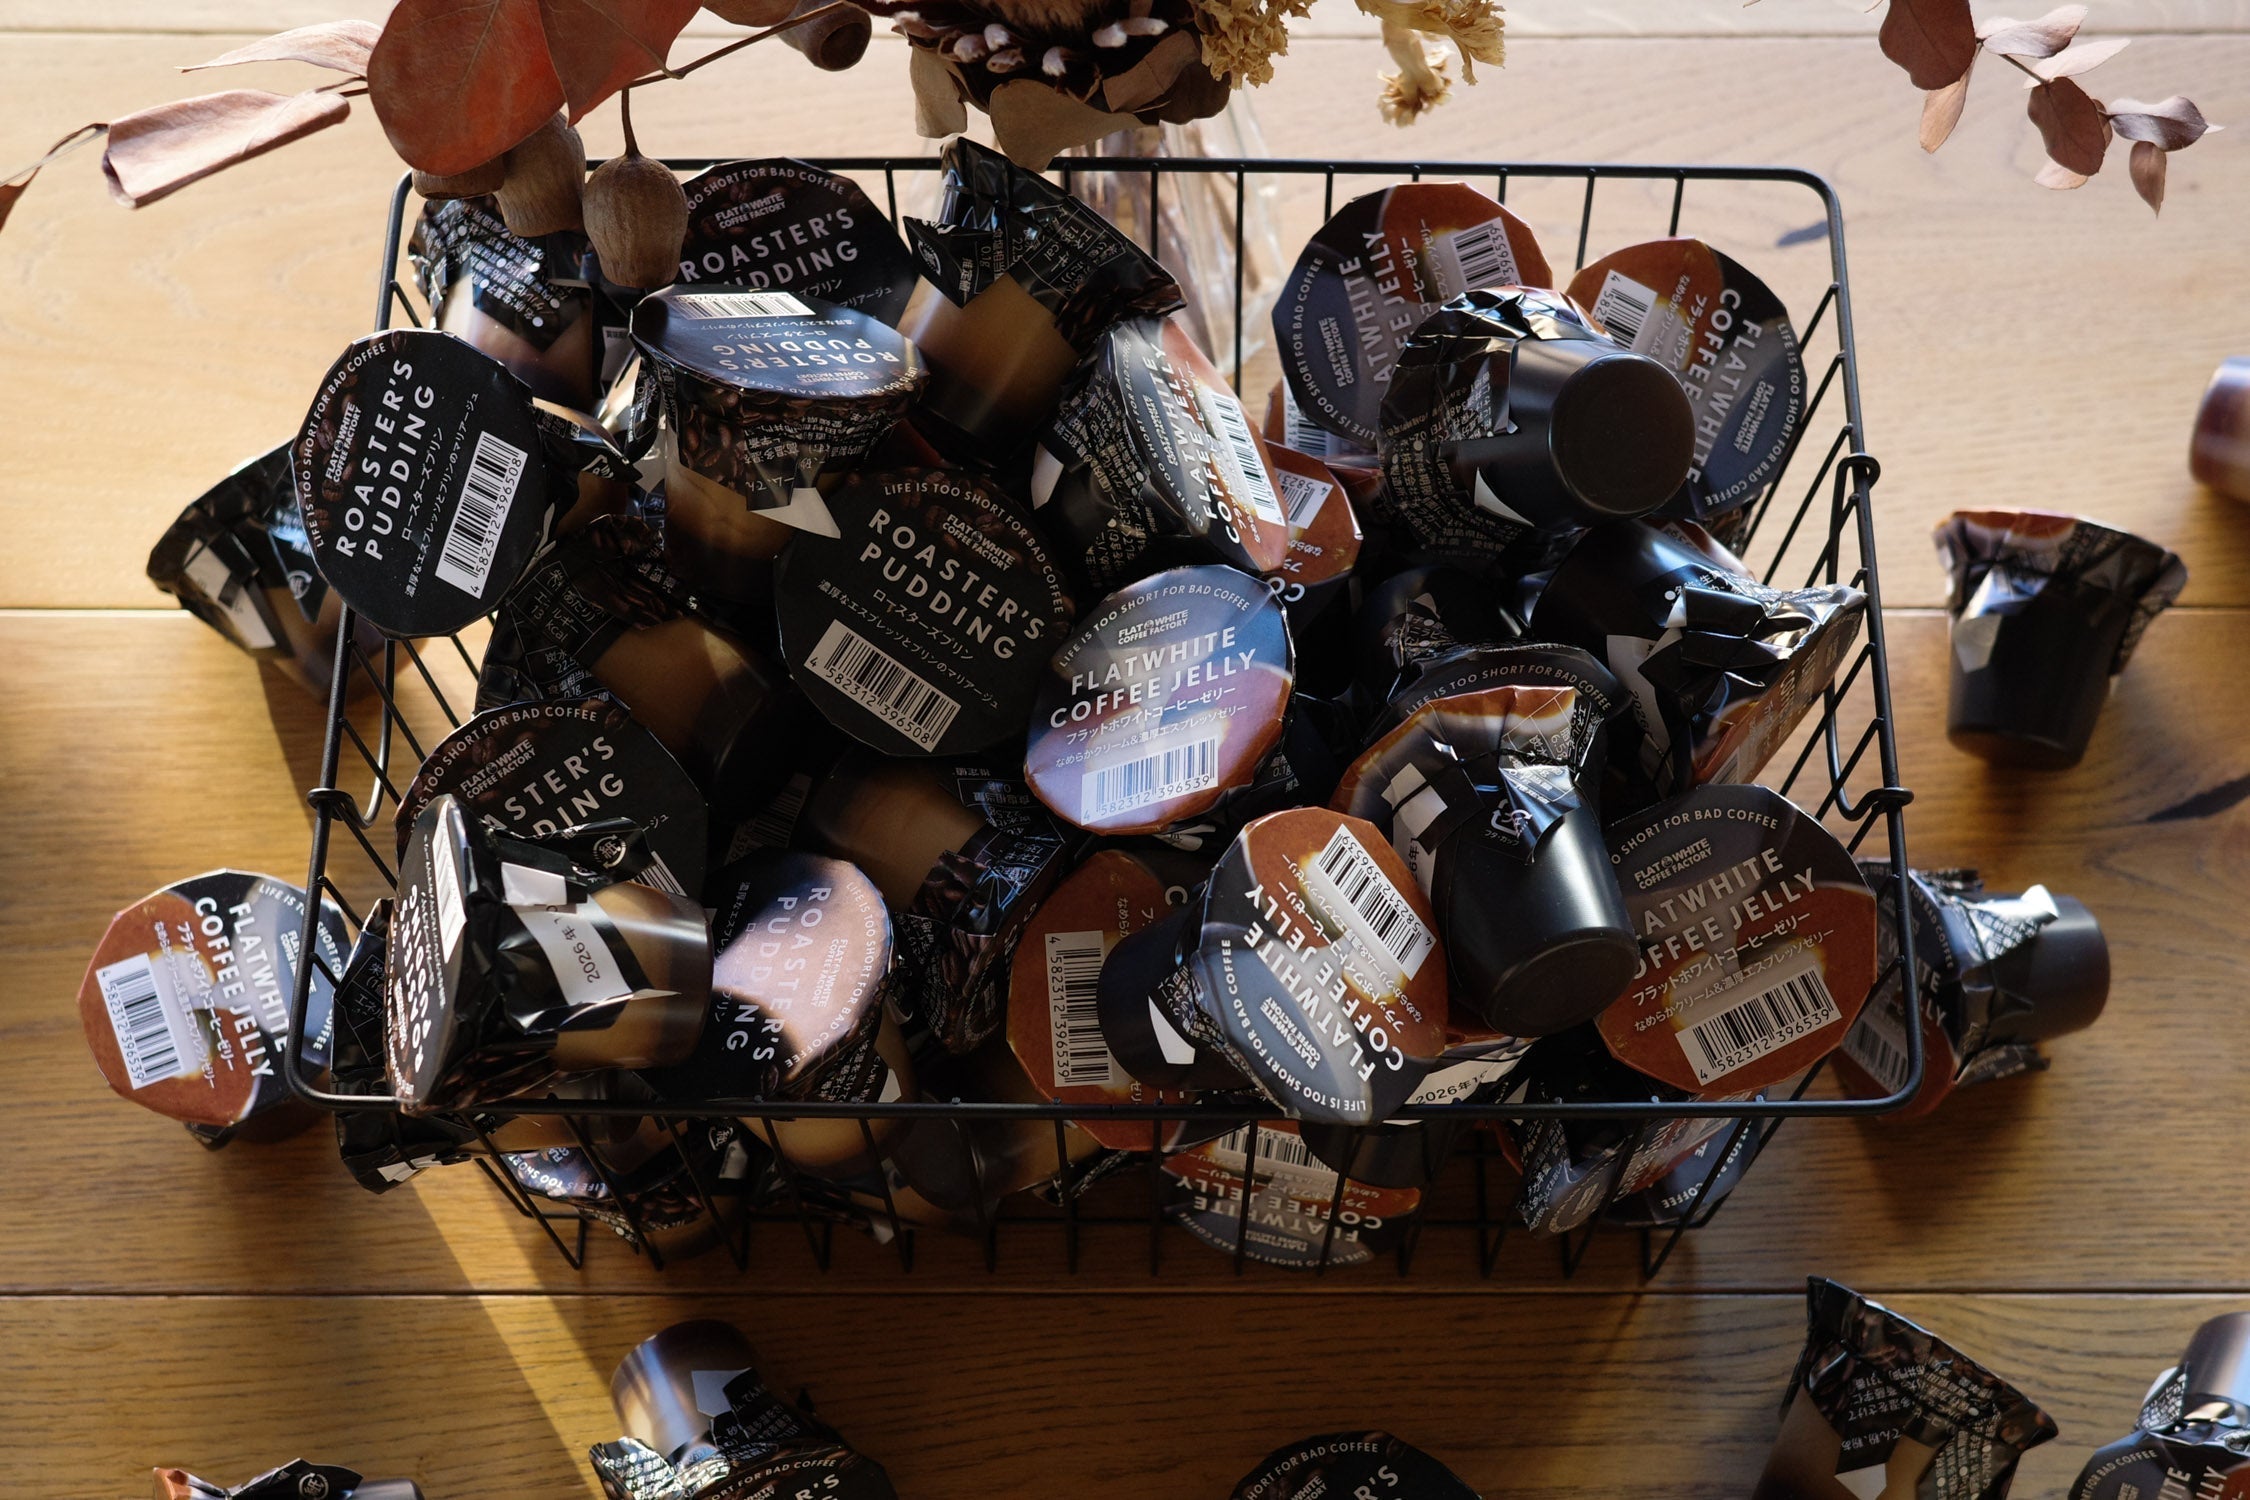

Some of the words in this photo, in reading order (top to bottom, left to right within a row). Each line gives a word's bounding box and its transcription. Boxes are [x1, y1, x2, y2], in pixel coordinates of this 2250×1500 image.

[703, 173, 740, 197] SHORT
[743, 168, 767, 180] FOR
[769, 167, 795, 178] BAD
[798, 171, 845, 195] COFFEE
[749, 192, 784, 211] WHITE
[750, 201, 786, 220] FACTORY
[680, 208, 855, 283] ROASTER'S
[1297, 257, 1324, 301] COFFEE
[1362, 232, 1405, 306] JELLY
[1292, 305, 1304, 330] BAD
[713, 338, 873, 357] PUDDING
[1293, 333, 1304, 358] FOR
[1683, 288, 1741, 401] COFFEE
[1778, 323, 1793, 350] LIFE
[348, 342, 387, 373] COFFEE
[719, 351, 900, 372] ROASTER'S
[327, 370, 347, 396] BAD
[1297, 361, 1320, 397] SHORT
[1789, 368, 1800, 394] TOO
[313, 394, 331, 420] FOR
[1318, 397, 1339, 418] TOO
[1338, 415, 1351, 428] IS
[1781, 399, 1798, 438] SHORT
[303, 424, 318, 466] SHORT
[344, 407, 363, 447] FACTORY
[1143, 357, 1218, 520] FLATWHITE
[1353, 423, 1376, 441] LIFE
[335, 359, 413, 557] ROASTER'S
[1767, 439, 1785, 462] FOR
[303, 473, 312, 499] TOO
[364, 385, 435, 560] PUDDING
[401, 427, 443, 541] ロースターズプリン
[1749, 461, 1770, 482] BAD
[304, 503, 314, 517] IS
[1705, 480, 1747, 505] COFFEE
[310, 519, 324, 548] LIFE
[476, 520, 500, 575] 582312
[495, 457, 523, 514] 396508
[884, 482, 912, 496] LIFE
[916, 482, 928, 493] IS
[933, 482, 961, 497] TOO
[964, 490, 1006, 520] SHORT
[1005, 515, 1028, 538] FOR
[1025, 536, 1046, 563] BAD
[1042, 564, 1065, 614] COFFEE
[971, 542, 1011, 572] FACTORY
[982, 536, 1016, 566] WHITE
[868, 508, 1045, 640] ROASTER'S
[859, 542, 1016, 660] PUDDING
[1059, 645, 1081, 668] LIFE
[1081, 632, 1092, 644] IS
[1093, 611, 1118, 633] TOO
[1121, 591, 1160, 615] SHORT
[1163, 585, 1186, 598] FOR
[1188, 584, 1212, 595] BAD
[1213, 587, 1250, 612] COFFEE
[1118, 625, 1145, 639] FLAT
[1153, 609, 1190, 627] WHITE
[1118, 632, 1148, 645] COFFEE
[1149, 618, 1189, 635] FACTORY
[1071, 626, 1237, 697] FLATWHITE
[826, 668, 876, 706] 582312
[880, 705, 930, 744] 396508
[1049, 676, 1161, 729] COFFEE
[1171, 648, 1257, 693] JELLY
[1406, 697, 1430, 716] LIFE
[1433, 685, 1447, 697] IS
[1450, 673, 1477, 689] TOO
[1481, 664, 1525, 680] SHORT
[1528, 664, 1552, 676] FOR
[1554, 669, 1578, 684] BAD
[1578, 680, 1611, 712] COFFEE
[422, 766, 445, 795] TOO
[442, 728, 482, 766] SHORT
[481, 715, 510, 736] FOR
[512, 706, 540, 722] BAD
[545, 706, 598, 722] COFFEE
[460, 770, 486, 793] FLAT
[496, 739, 534, 768] WHITE
[466, 776, 500, 800] COFFEE
[497, 748, 537, 779] FACTORY
[1101, 792, 1151, 817] 582312
[1158, 775, 1210, 798] 396539
[1621, 822, 1661, 856] SHORT
[1663, 812, 1690, 829] FOR
[1694, 807, 1722, 820] BAD
[1726, 808, 1779, 831] COFFEE
[1341, 835, 1382, 885] 396539
[1634, 860, 1663, 883] FLAT
[1670, 837, 1711, 862] WHITE
[1639, 868, 1673, 890] COFFEE
[1672, 847, 1713, 874] FACTORY
[259, 884, 283, 900] LIFE
[283, 896, 297, 907] IS
[846, 881, 864, 902] LIFE
[859, 899, 871, 913] IS
[1729, 866, 1817, 930] JELLY
[863, 912, 876, 937] TOO
[1244, 884, 1317, 959] JELLY
[1380, 885, 1422, 935] 582312
[726, 895, 798, 1052] PUDDING
[752, 887, 833, 1061] ROASTER'S
[864, 940, 876, 978] SHORT
[1221, 939, 1238, 995] COFFEE
[195, 897, 247, 1000] COFFEE
[229, 1003, 275, 1078] JELLY
[228, 902, 289, 1053] FLATWHITE
[847, 981, 867, 1005] FOR
[1050, 956, 1066, 1013] 582312
[830, 1007, 851, 1030] BAD
[1233, 999, 1251, 1028] BAD
[1243, 921, 1376, 1083] FLATWHITE
[1260, 1002, 1289, 1038] WHITE
[1265, 997, 1298, 1033] FACTORY
[1314, 961, 1404, 1072] COFFEE
[105, 982, 129, 1032] 582312
[120, 1033, 145, 1081] 396539
[785, 1031, 830, 1068] COFFEE
[1247, 1029, 1268, 1057] FOR
[1296, 1031, 1321, 1062] COFFEE
[1717, 1039, 1773, 1072] 582312
[1775, 1009, 1832, 1044] 396539
[1054, 1022, 1070, 1078] 396539
[1293, 1043, 1317, 1070] FLAT
[1265, 1056, 1302, 1091] SHORT
[1303, 1087, 1326, 1105] TOO
[1330, 1097, 1341, 1109] IS
[1344, 1100, 1366, 1111] LIFE
[737, 1471, 762, 1489] FOR
[764, 1463, 791, 1476] BAD
[793, 1458, 837, 1471] COFFEE
[1274, 1456, 1300, 1476] FOR
[1300, 1445, 1326, 1463] BAD
[1329, 1441, 1379, 1455] COFFEE
[2100, 1463, 2116, 1477] BAD
[2116, 1449, 2158, 1466] COFFEE
